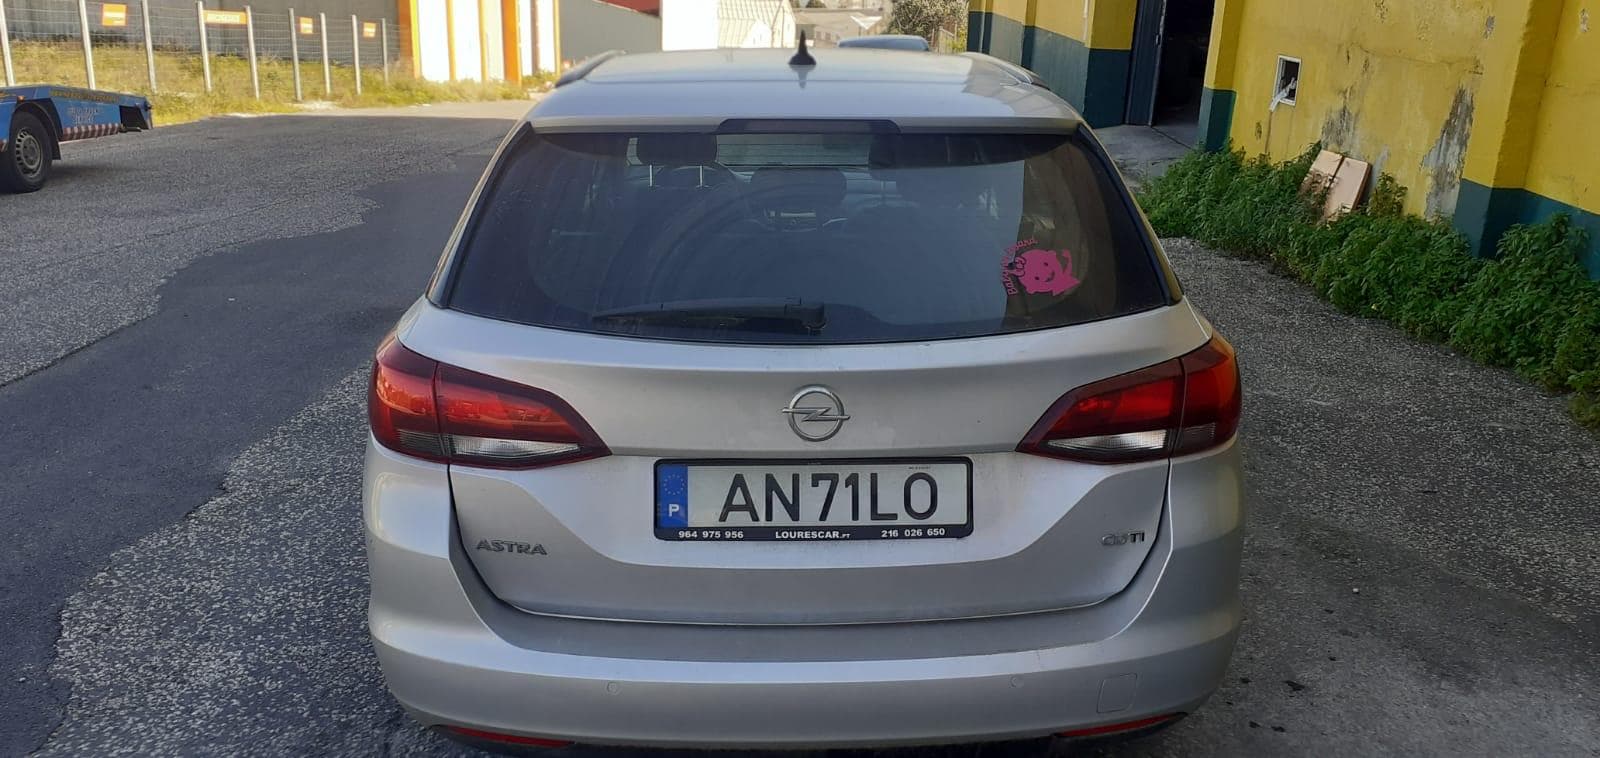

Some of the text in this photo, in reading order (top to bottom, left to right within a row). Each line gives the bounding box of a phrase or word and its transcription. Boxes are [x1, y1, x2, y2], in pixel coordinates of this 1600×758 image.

[668, 503, 680, 517] P
[678, 530, 744, 539] 964 975 956
[881, 527, 946, 538] 216 026 650
[476, 539, 548, 556] ASTRA
